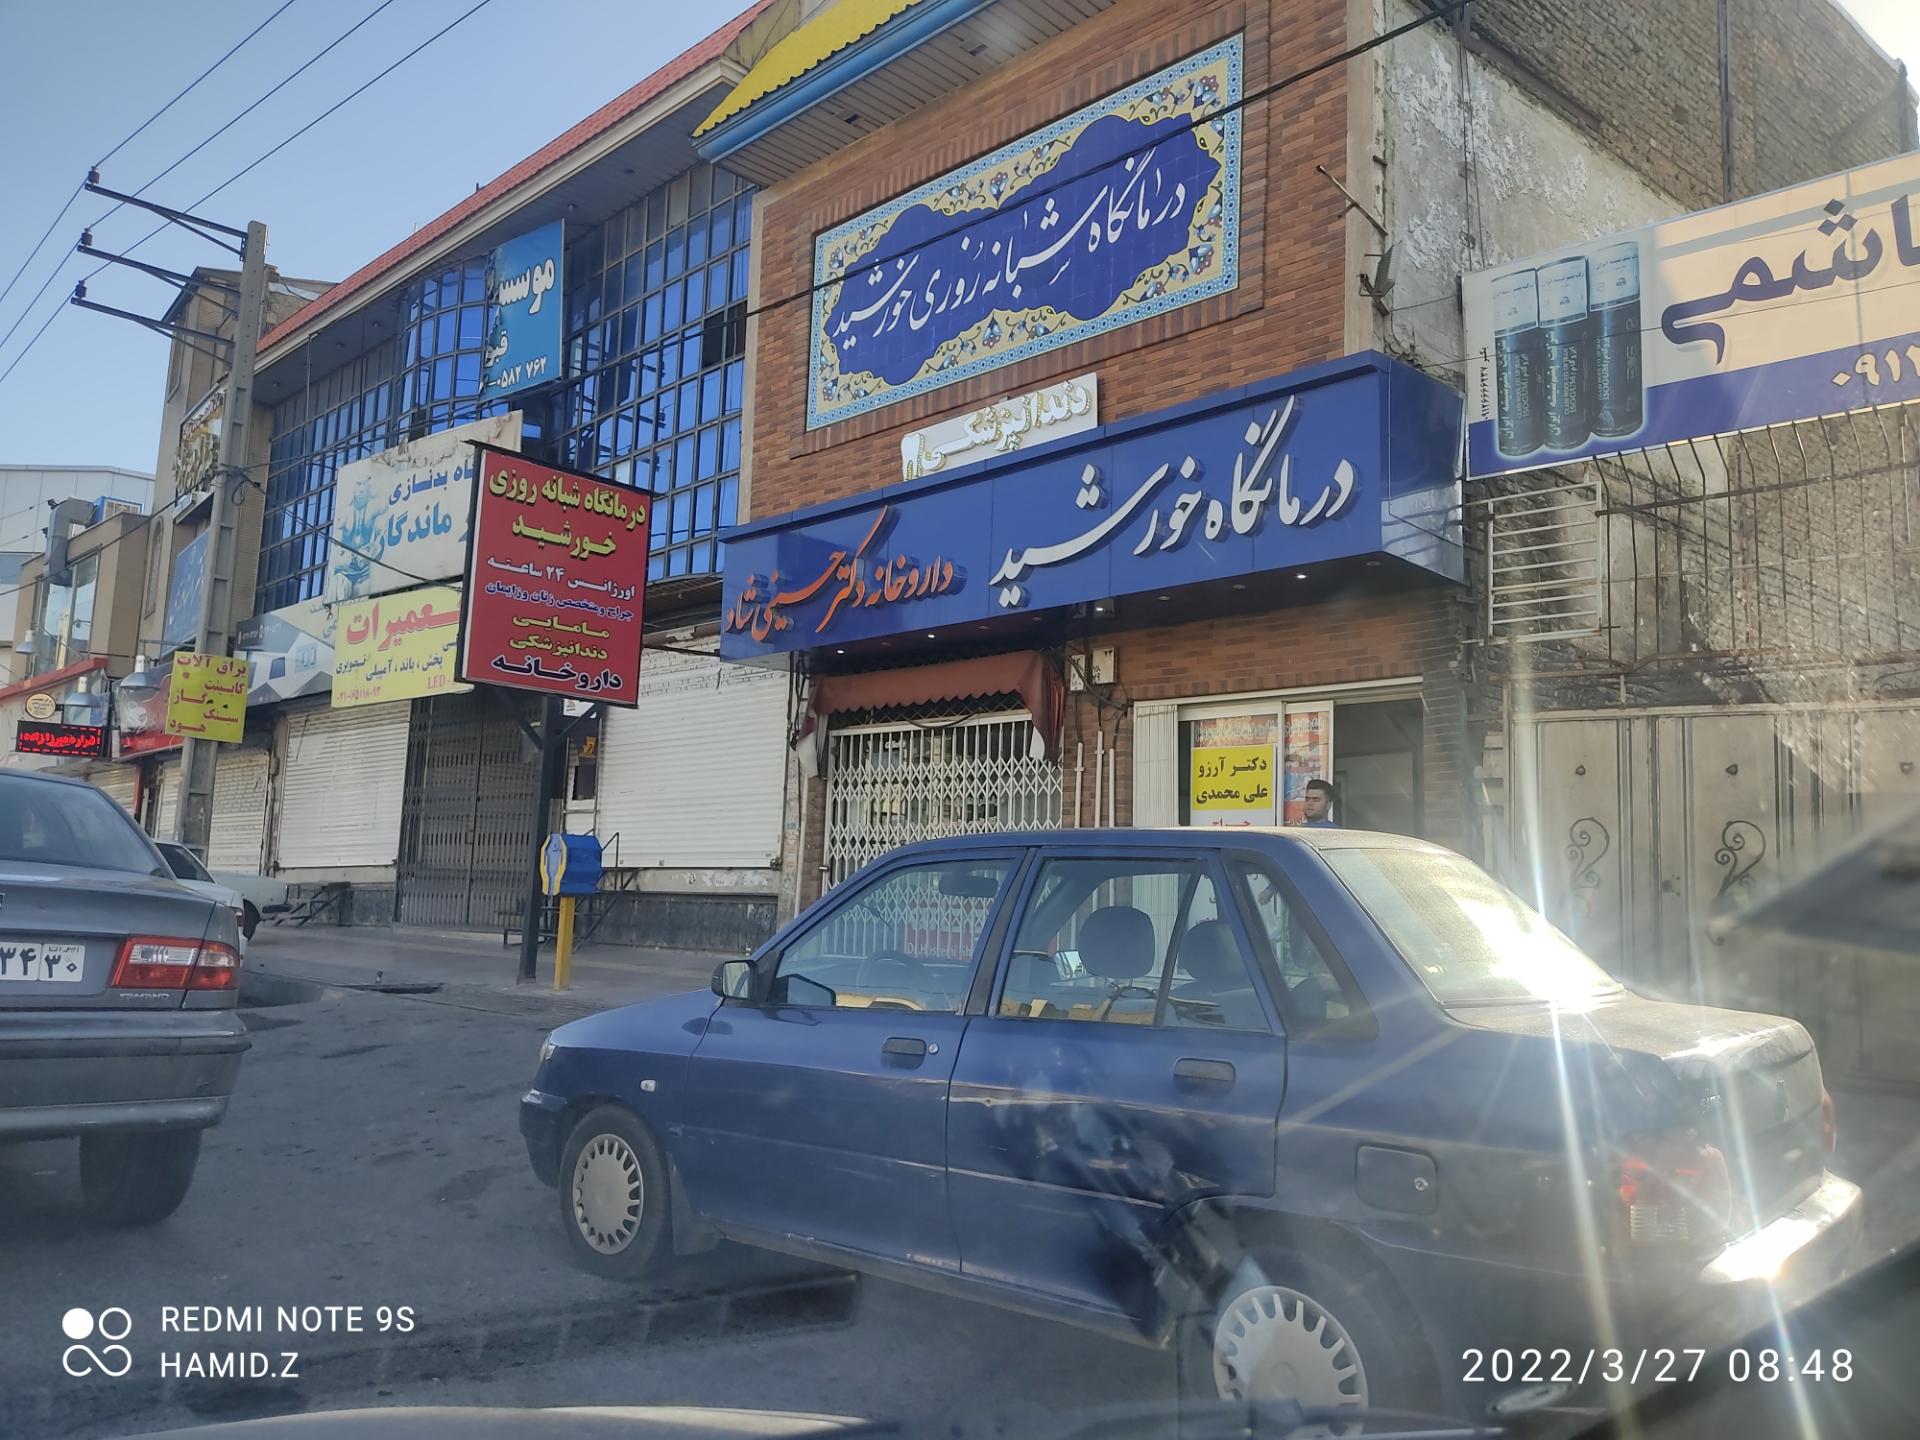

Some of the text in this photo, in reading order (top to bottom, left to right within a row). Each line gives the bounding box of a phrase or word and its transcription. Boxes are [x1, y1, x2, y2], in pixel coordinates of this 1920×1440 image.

[1088, 146, 1186, 253] درمانگاه
[832, 253, 920, 351] خورشید
[489, 468, 538, 504] روزی
[541, 474, 581, 512] شبانه
[988, 394, 1356, 608] درمانگاه خورشید
[584, 486, 646, 530] درمانگاه
[512, 514, 617, 560] خورشید
[487, 556, 635, 600] اورژانس ۲۴ ساعته
[864, 553, 953, 607] داروخانه
[347, 600, 460, 652] عمیرات
[512, 615, 611, 639] مامایی
[509, 634, 609, 660] دندانپزشکی
[491, 654, 623, 691] داروخانه
[169, 719, 206, 733] هود
[1197, 756, 1267, 778] دکتر آرزو
[1196, 783, 1268, 804] علی محمدی
[44, 954, 78, 979] ۳۰
